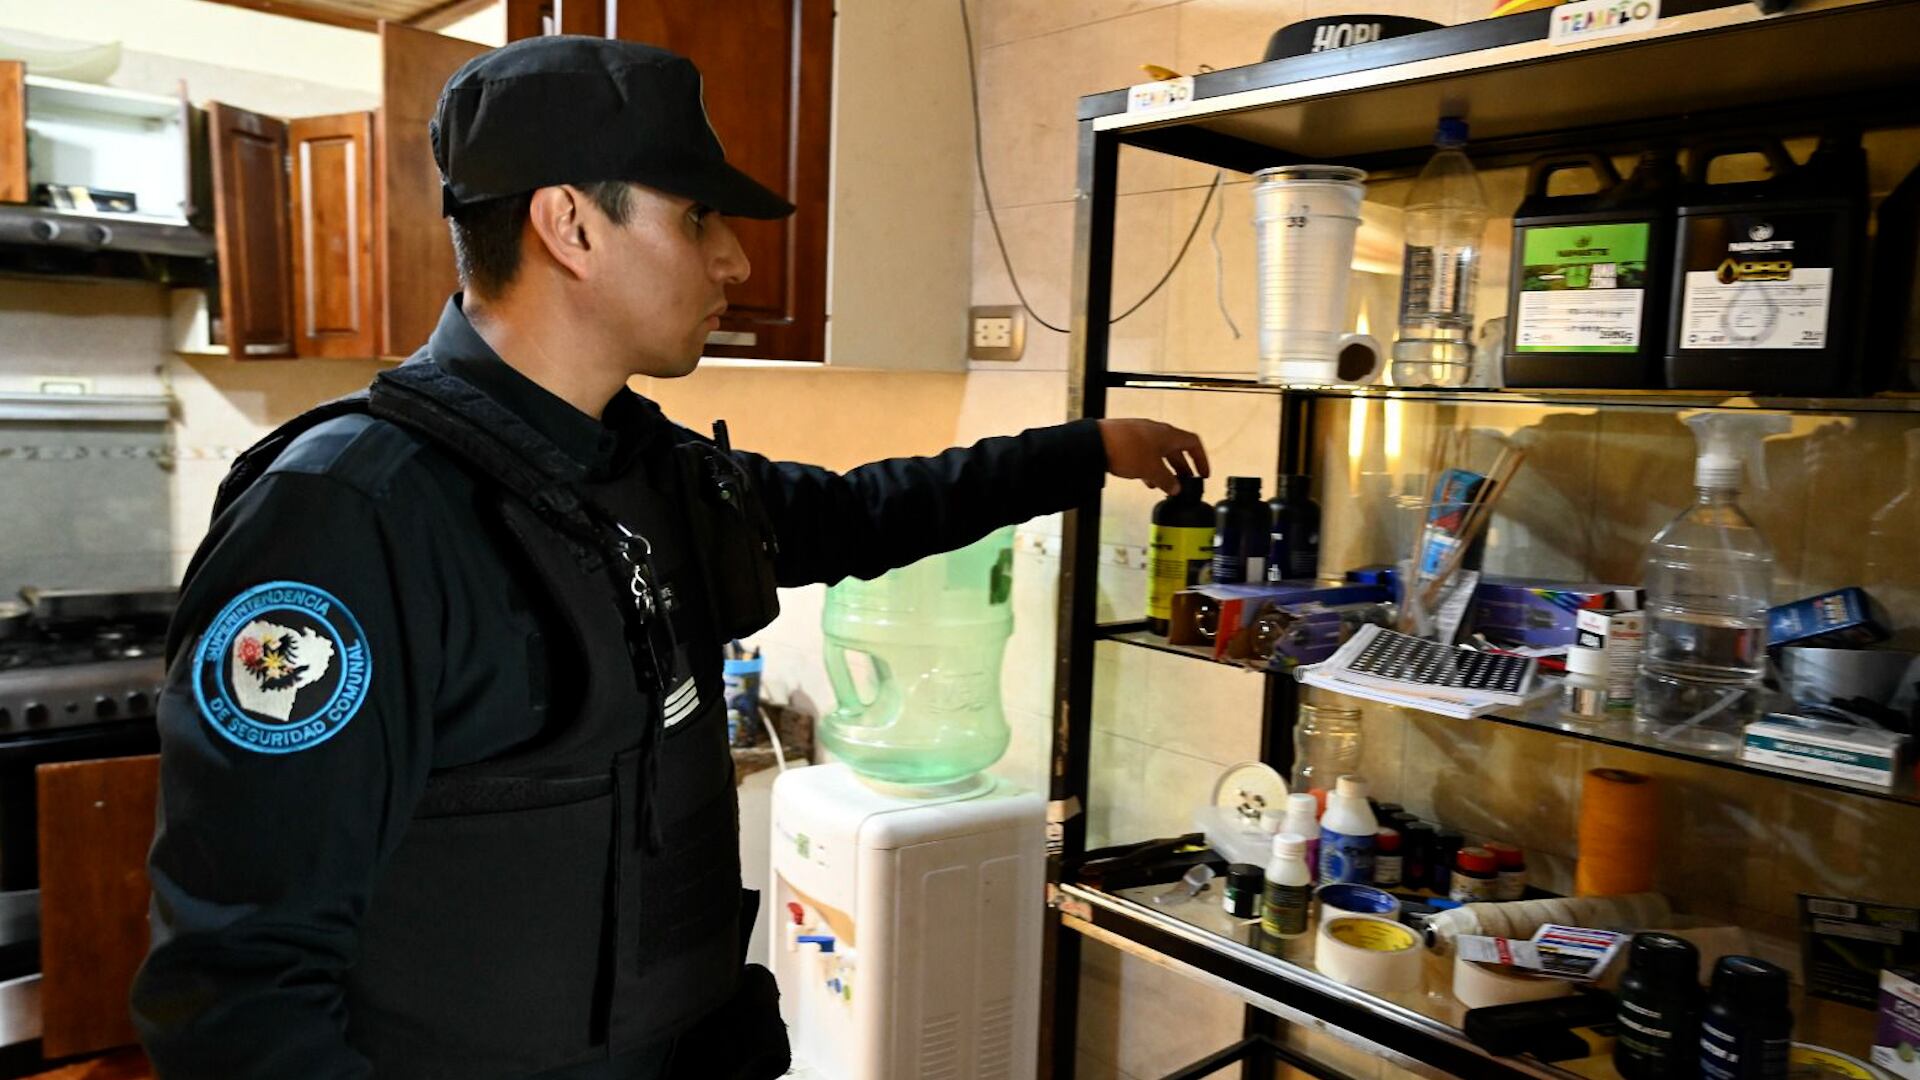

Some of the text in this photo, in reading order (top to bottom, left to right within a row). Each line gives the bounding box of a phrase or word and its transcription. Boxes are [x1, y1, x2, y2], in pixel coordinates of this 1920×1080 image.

[206, 589, 331, 662] SUPERINTENDENCIA
[210, 638, 364, 747] DE SEGURIDAD COMUNAL
